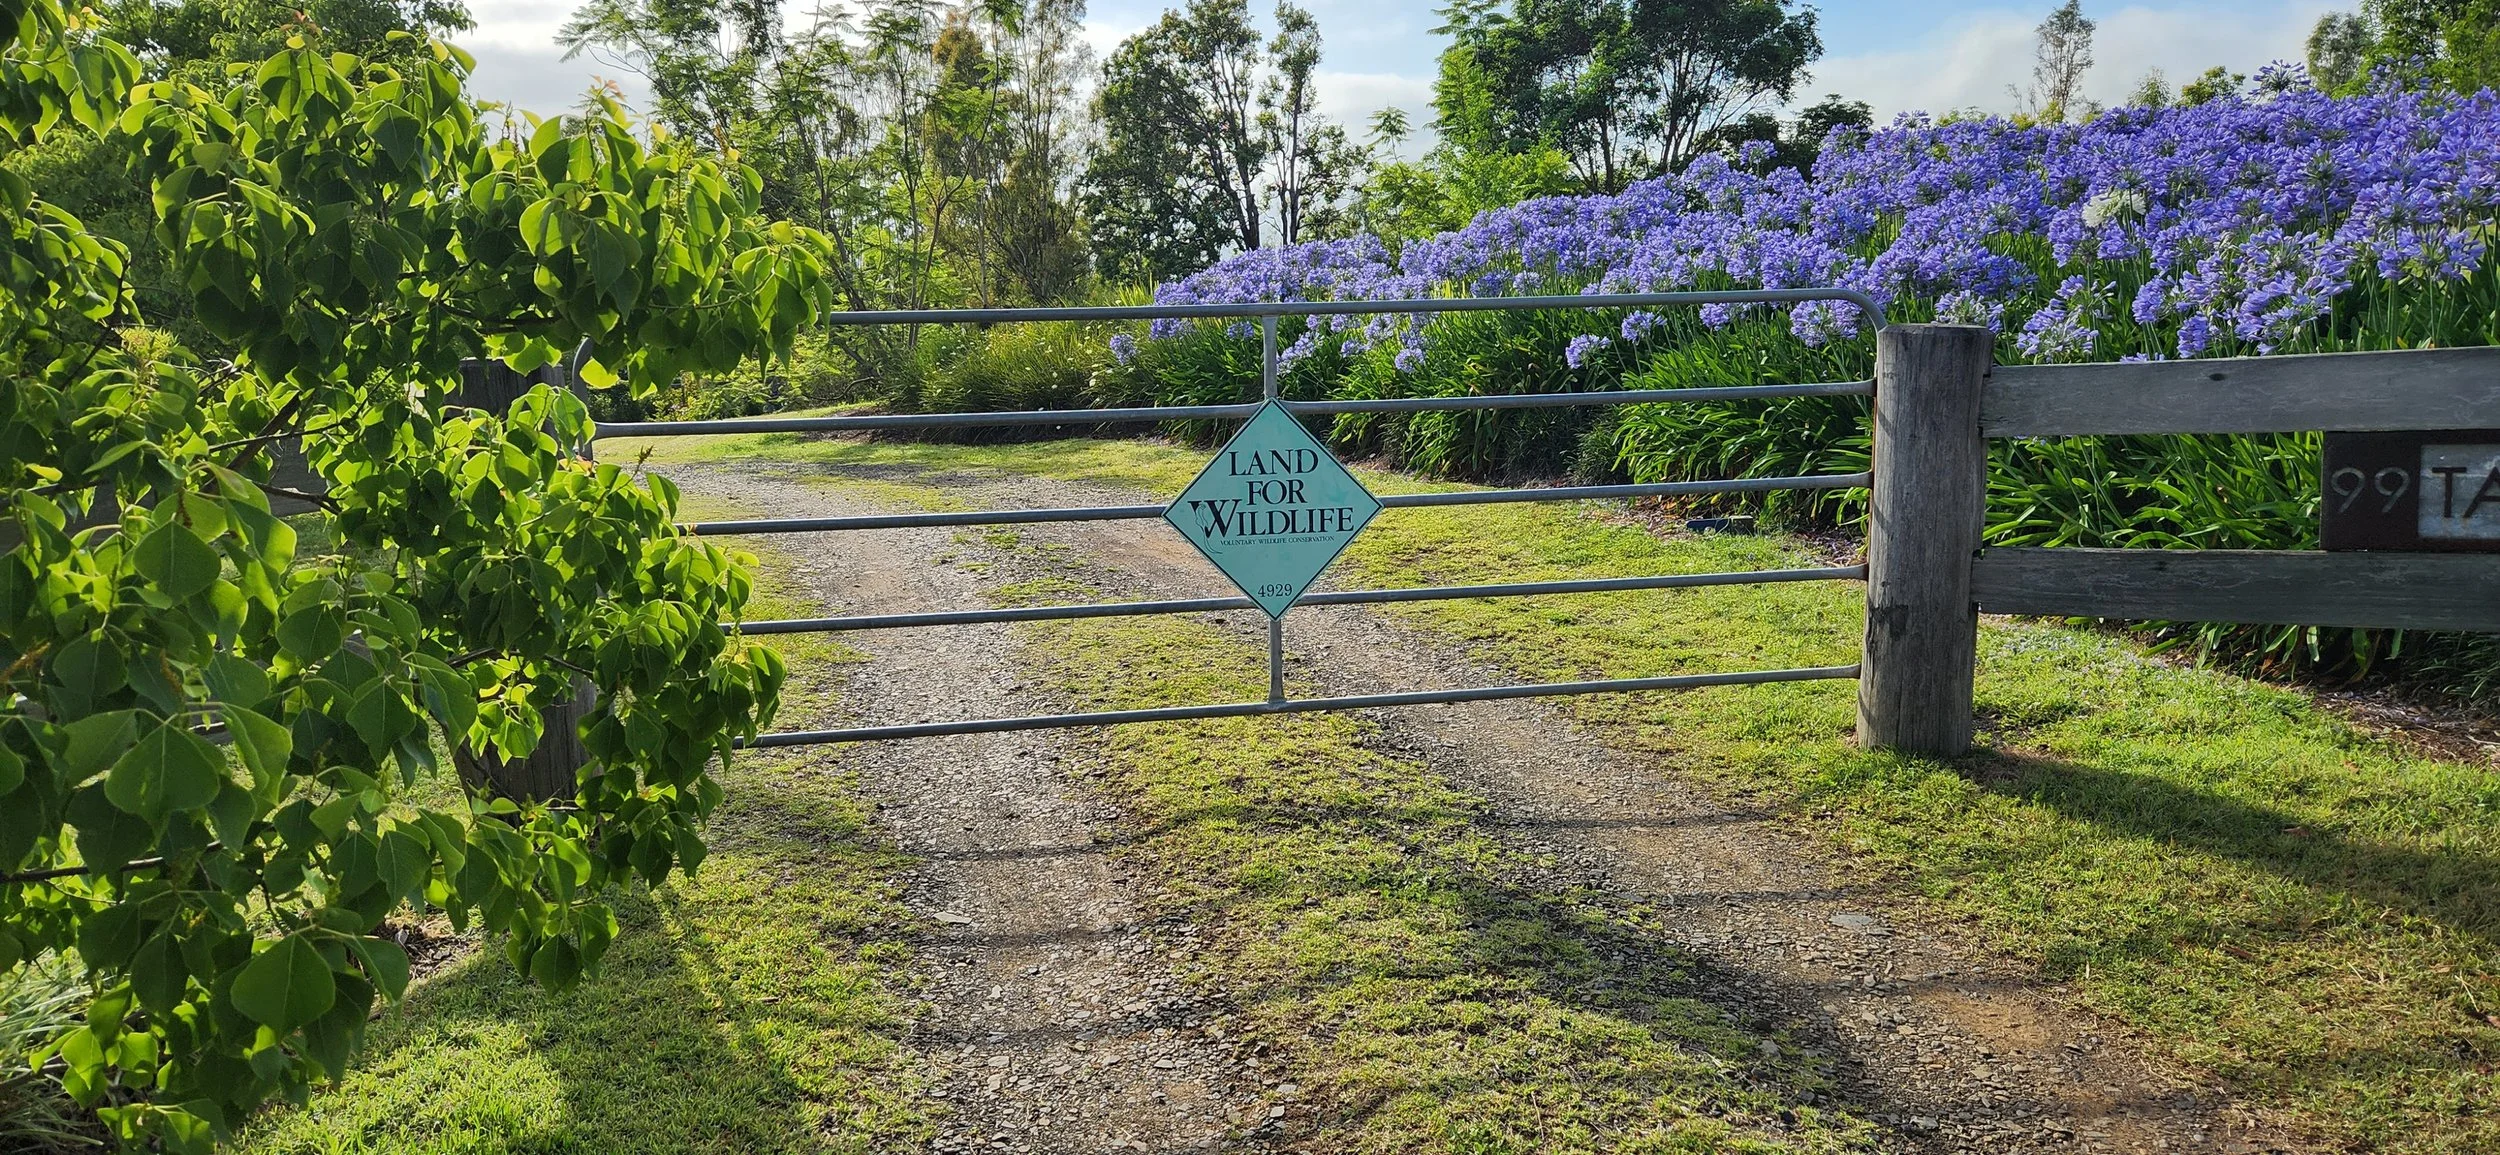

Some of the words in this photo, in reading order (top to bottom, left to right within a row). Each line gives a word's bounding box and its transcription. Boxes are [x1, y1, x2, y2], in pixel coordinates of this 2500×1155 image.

[1228, 448, 1319, 477] LAND
[1246, 478, 1308, 506] FOR
[2331, 467, 2411, 513] 99
[1187, 498, 1355, 538] WILDLIFE
[1258, 537, 1287, 545] WILDLIFE
[1289, 535, 1335, 544] CONSERVATION
[1257, 583, 1293, 598] 4929
